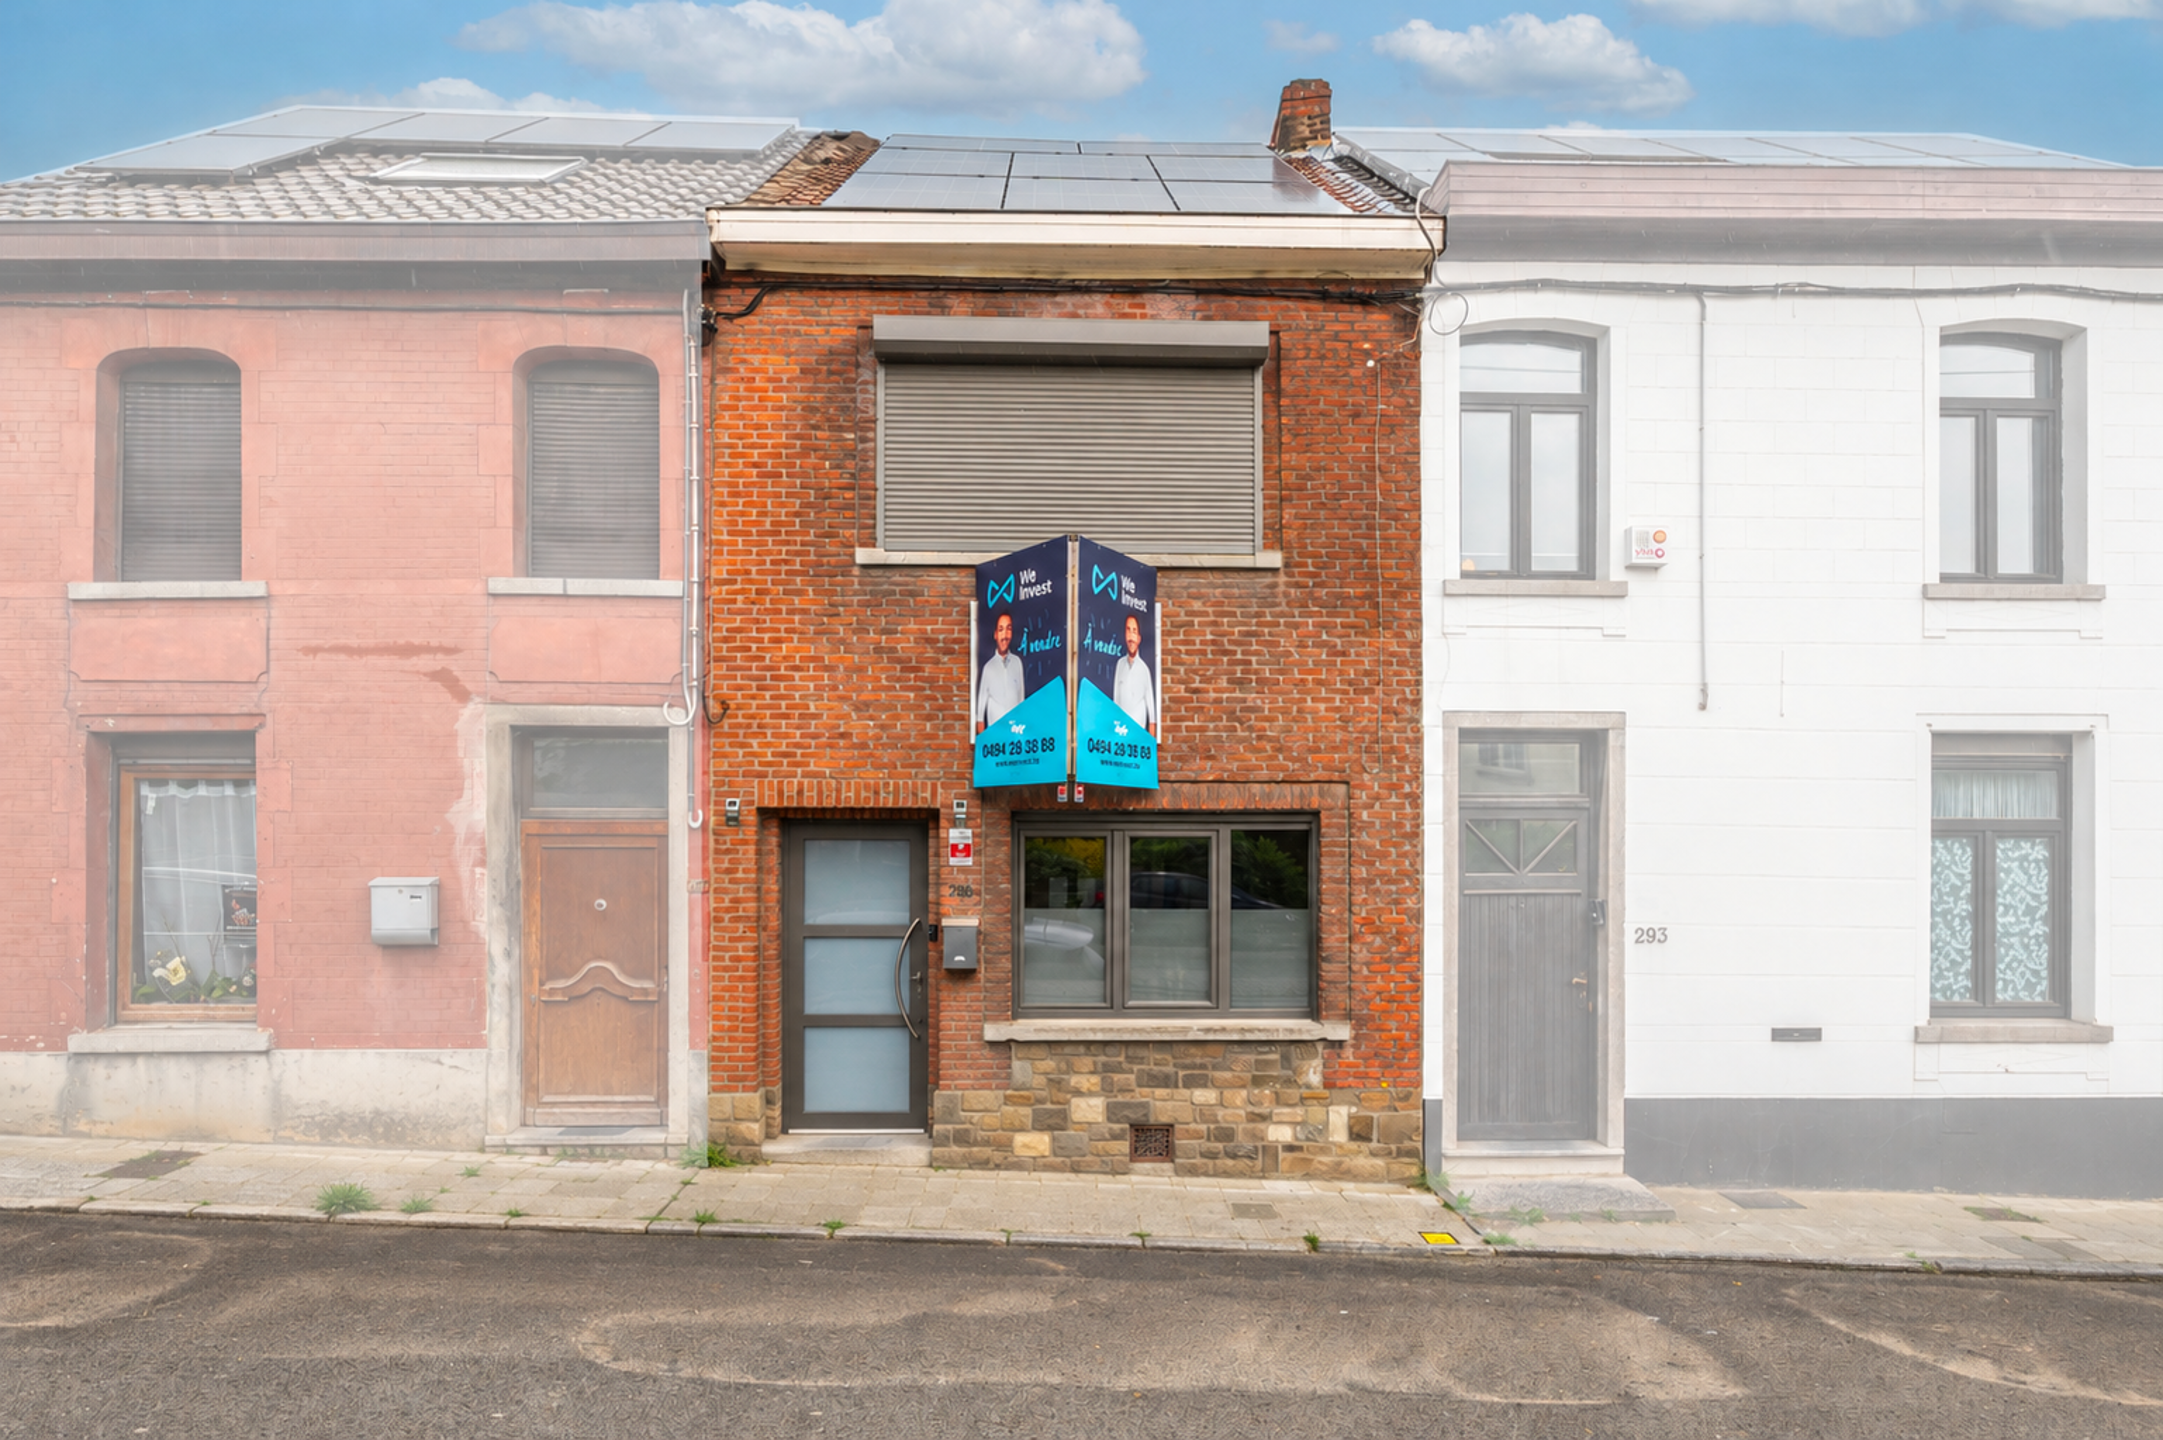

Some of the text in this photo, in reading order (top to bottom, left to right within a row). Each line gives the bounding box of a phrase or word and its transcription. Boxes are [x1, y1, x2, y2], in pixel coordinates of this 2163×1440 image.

[1019, 568, 1036, 585] We
[1121, 574, 1136, 593] We
[1634, 926, 1668, 944] 293
